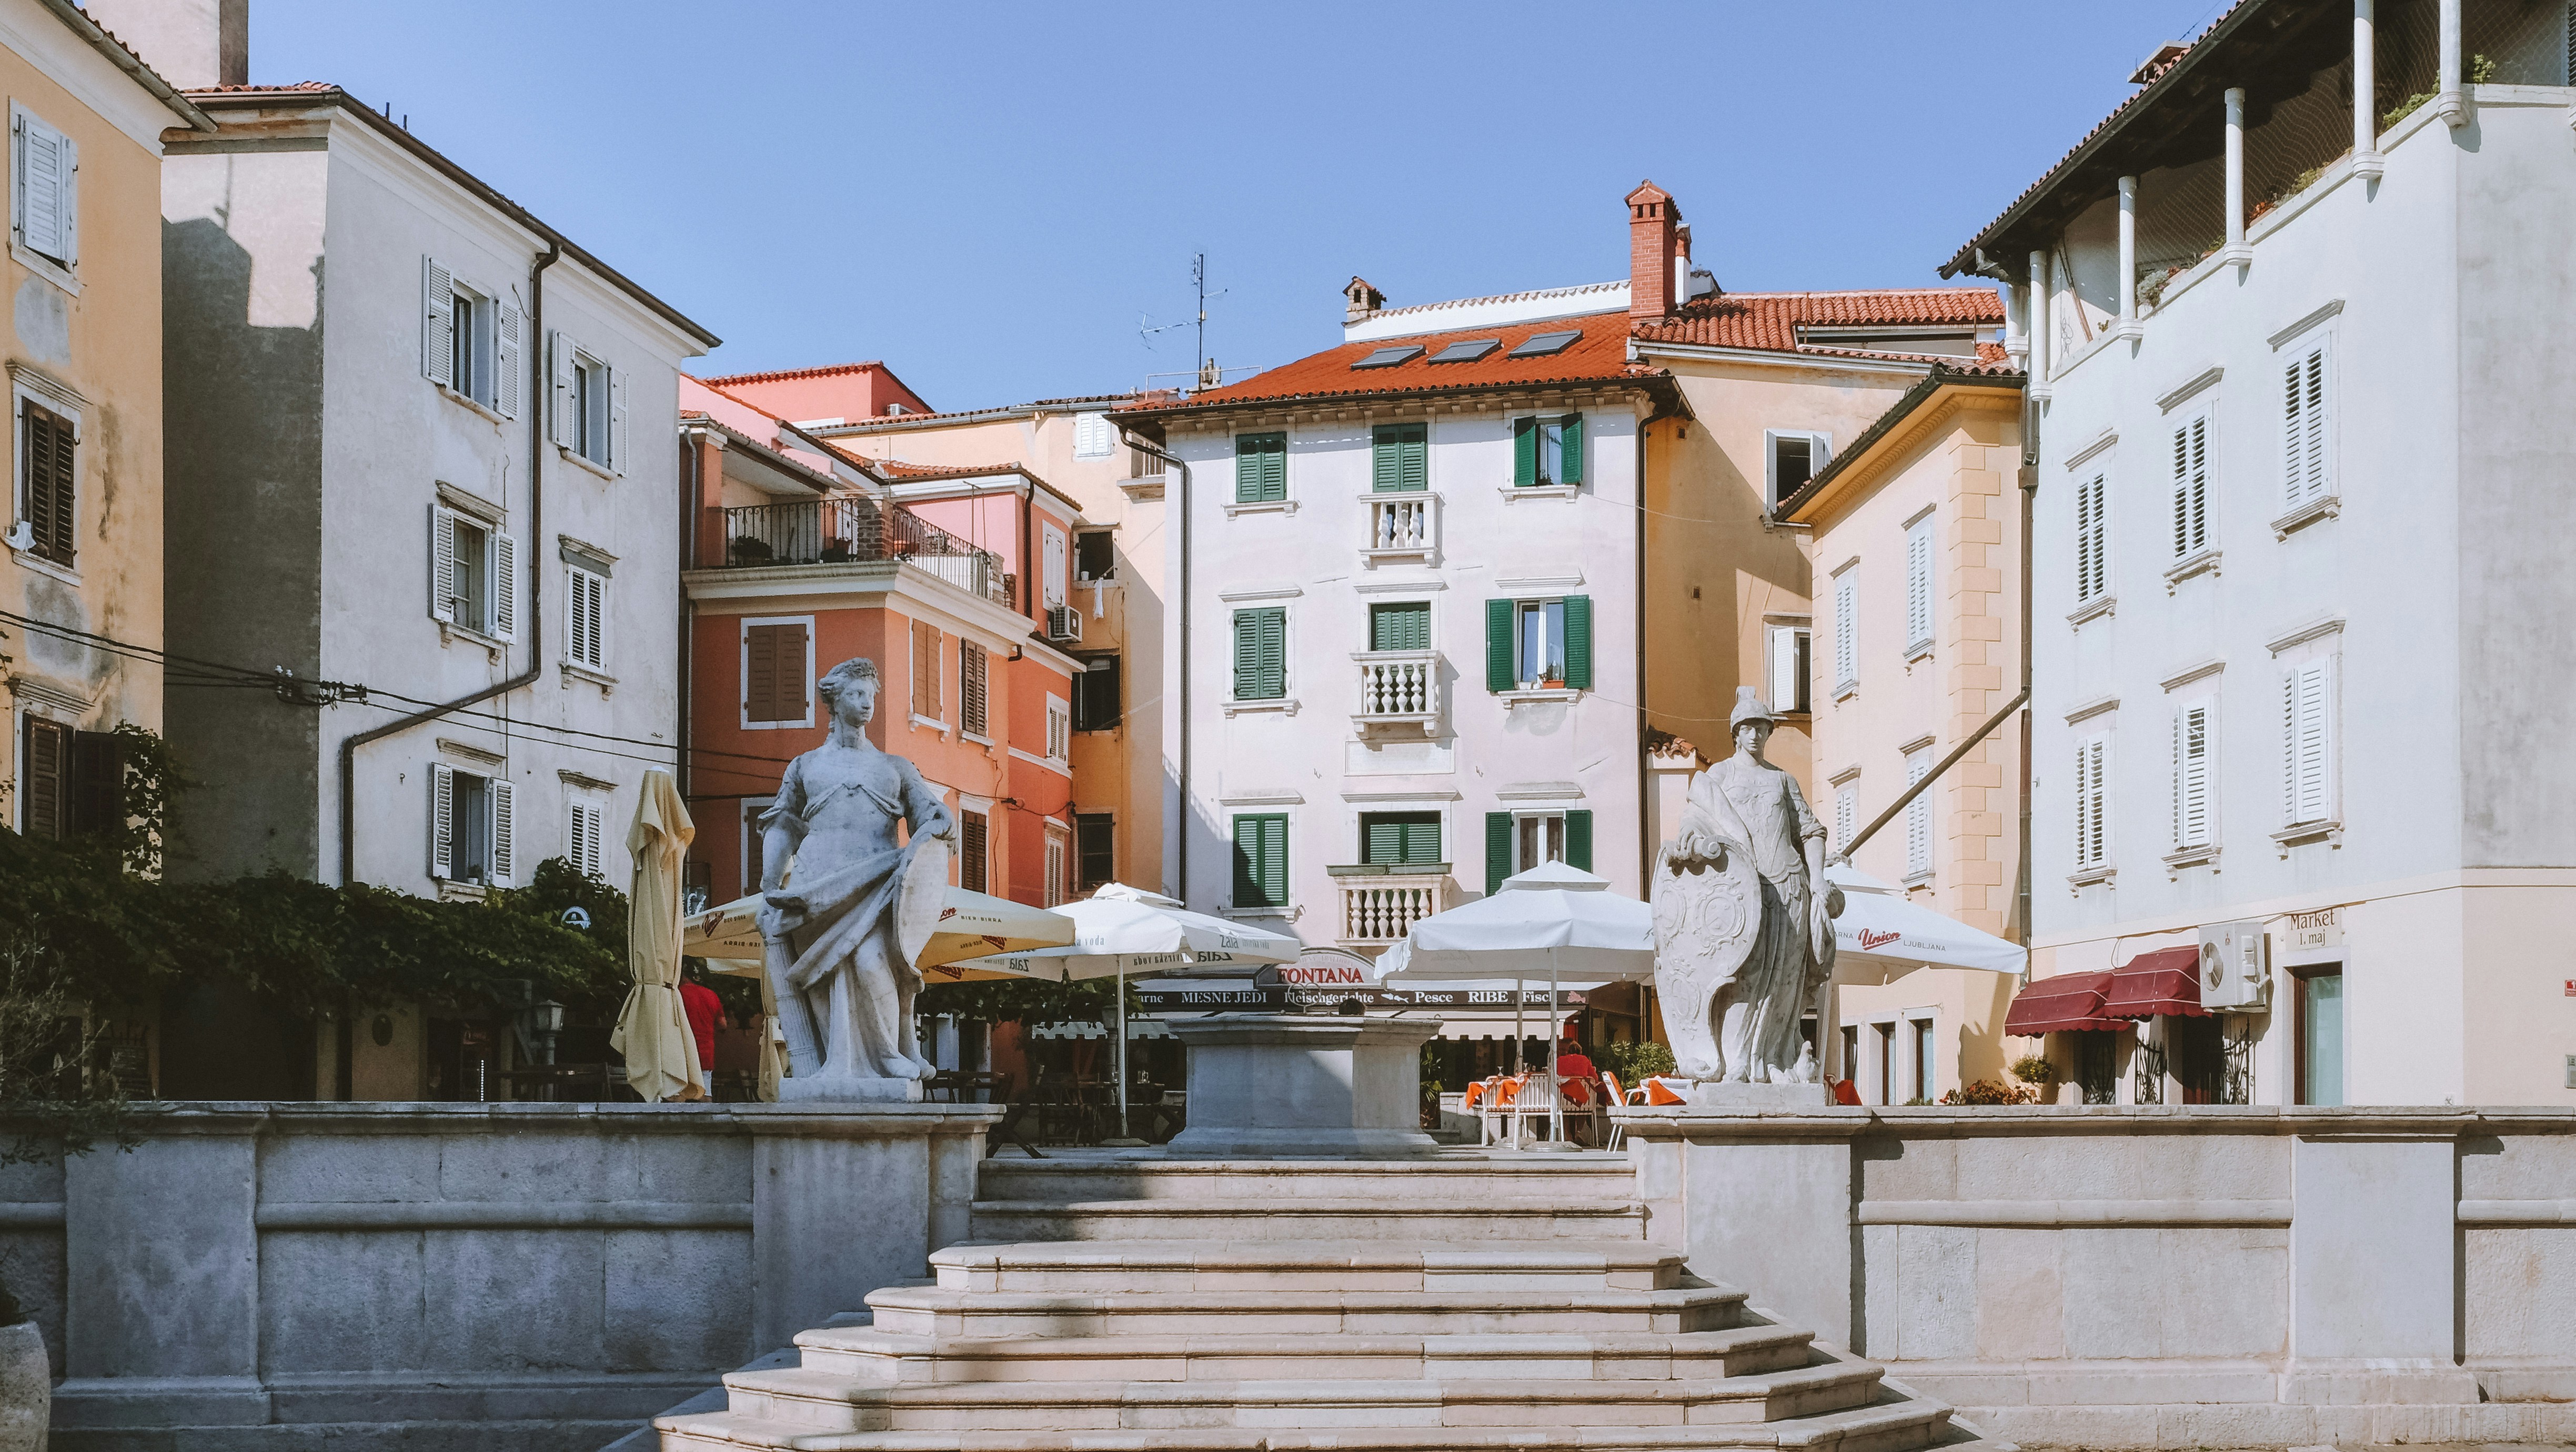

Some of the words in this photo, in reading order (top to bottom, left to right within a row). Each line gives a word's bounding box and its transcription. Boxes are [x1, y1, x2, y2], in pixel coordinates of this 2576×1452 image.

[2290, 909, 2335, 930] Market
[1858, 928, 1901, 951] Union
[1903, 940, 1946, 951] LJUBLJANA
[2309, 929, 2327, 946] maj
[1276, 967, 1364, 984] FONTANA
[1139, 994, 1164, 1003] arne
[1182, 992, 1232, 1003] MESNE
[1234, 992, 1267, 1003] JEDI
[1414, 991, 1454, 1003] Pesce
[1467, 991, 1509, 1003] RIBE
